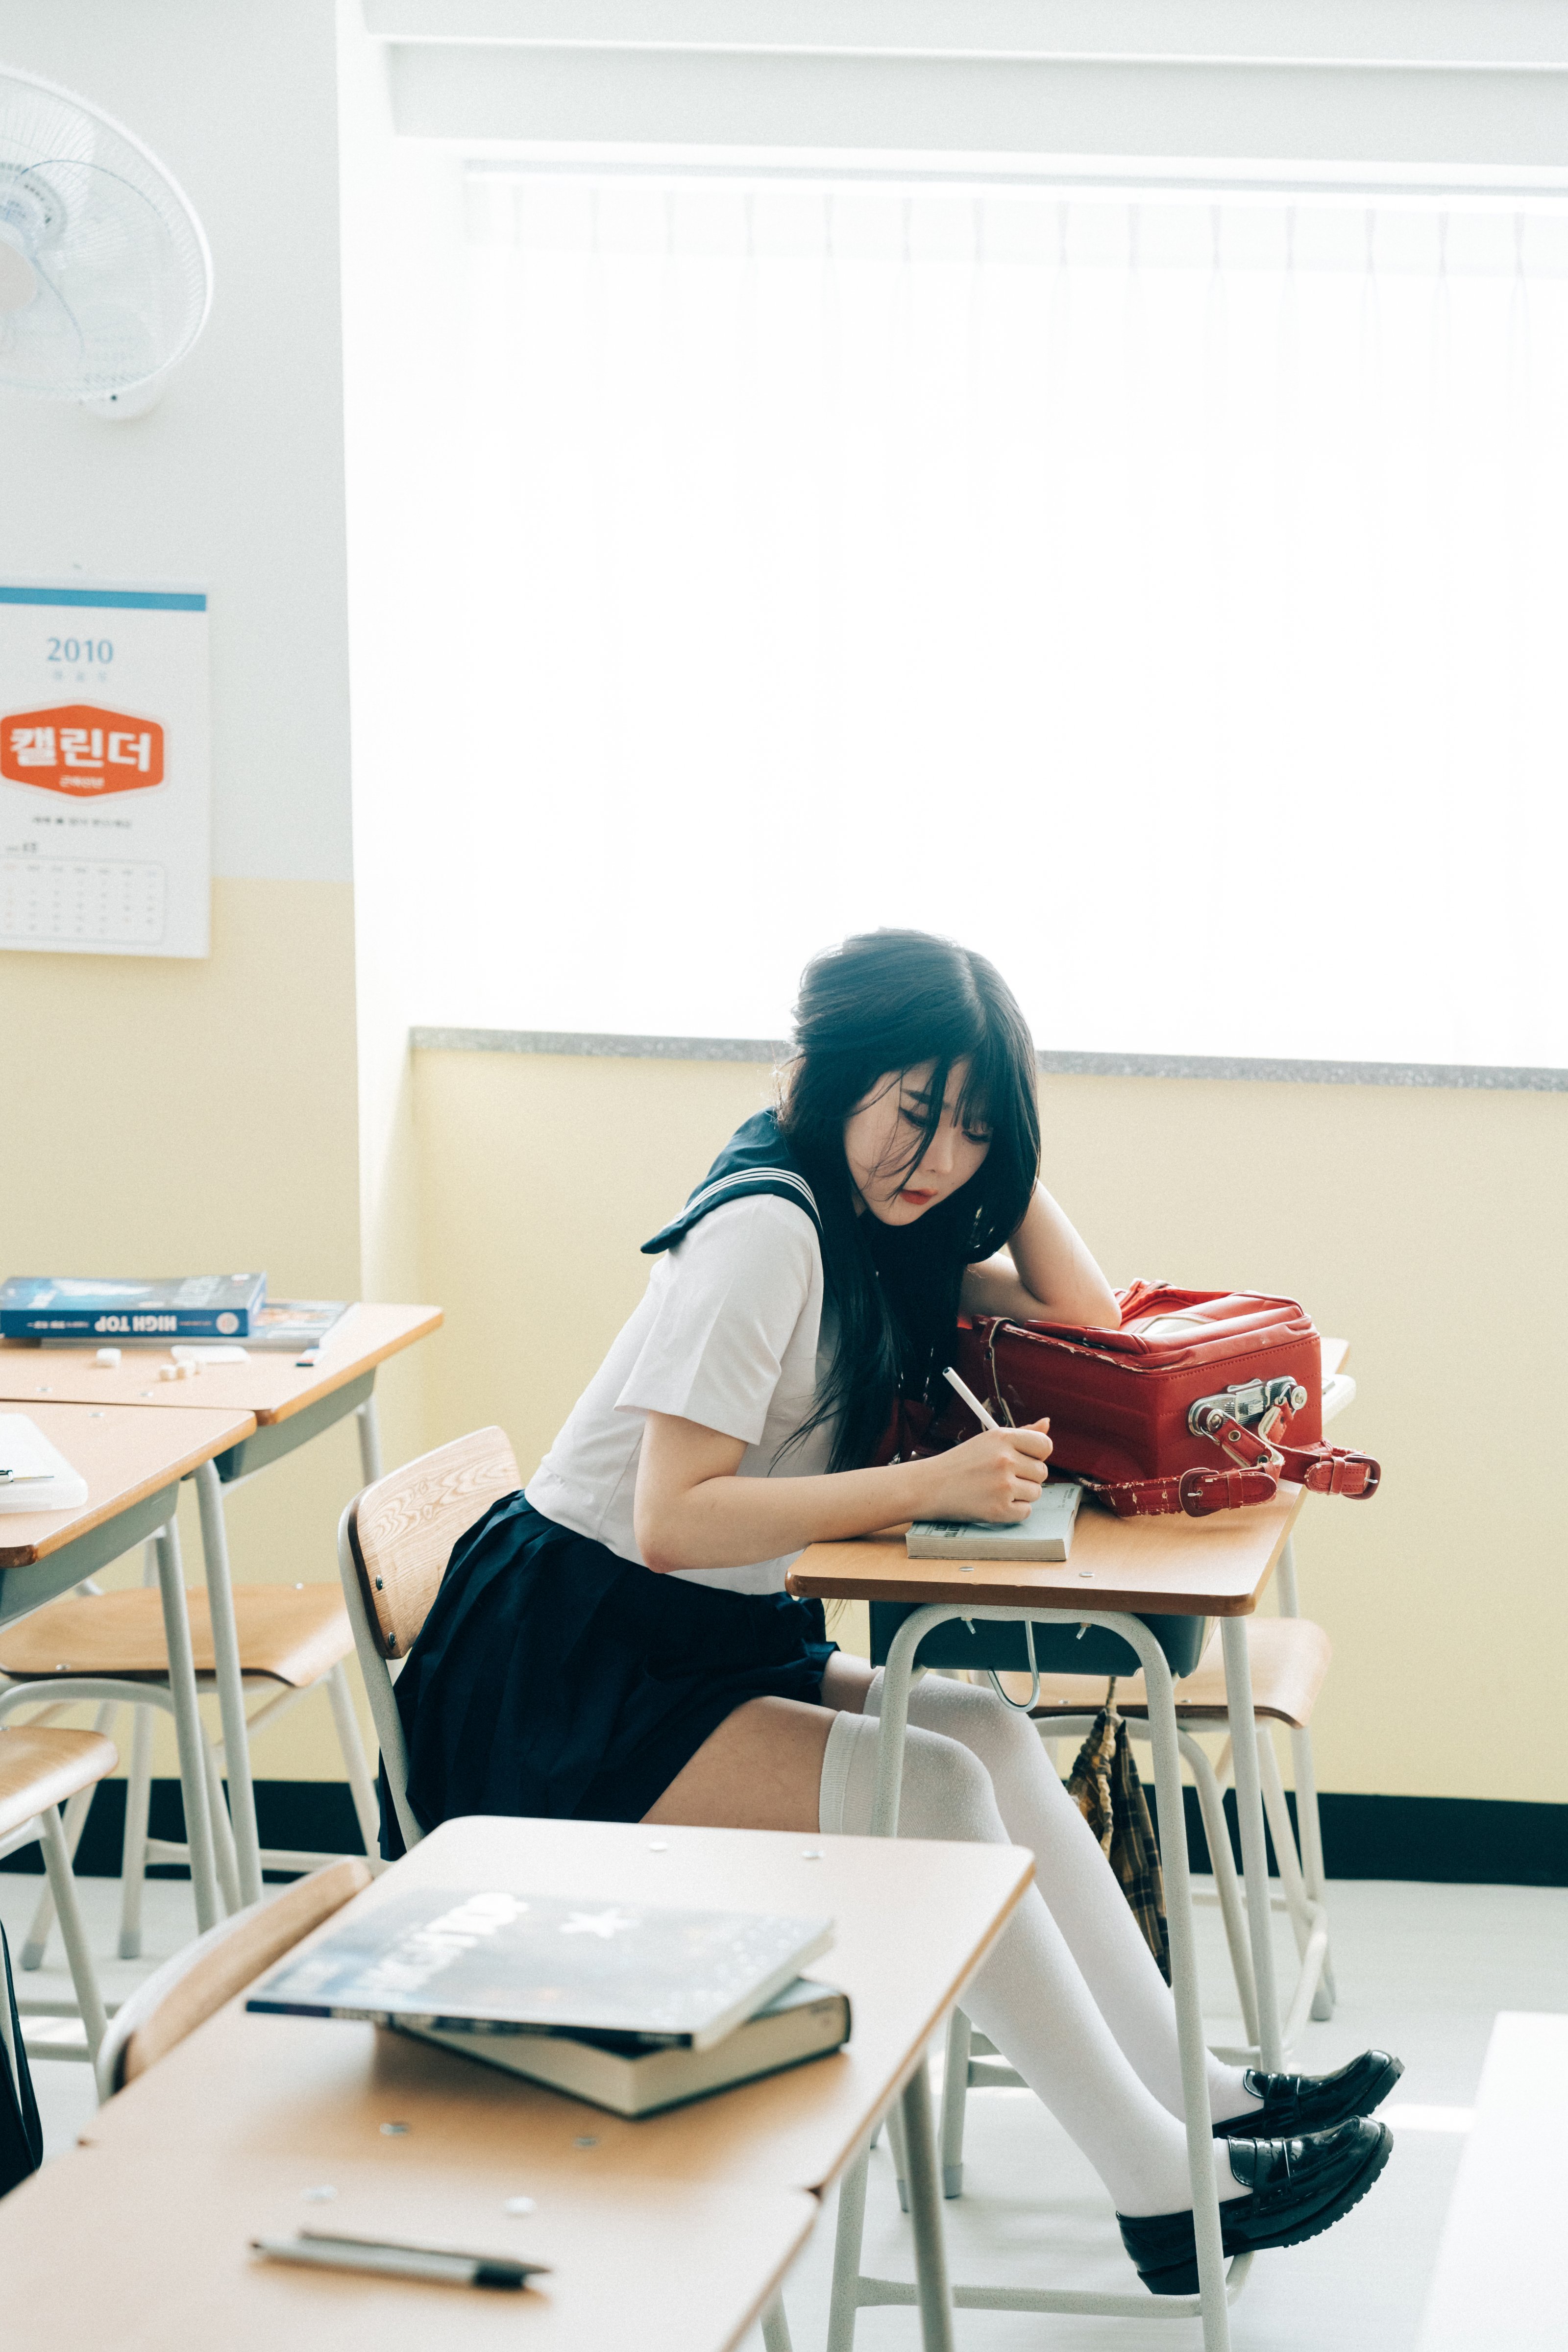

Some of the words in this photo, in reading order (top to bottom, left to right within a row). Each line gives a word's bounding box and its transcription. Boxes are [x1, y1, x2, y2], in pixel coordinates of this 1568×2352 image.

[48, 637, 114, 664] 2010
[10, 726, 151, 772] 캘린더
[94, 1315, 130, 1332] TOP
[132, 1315, 177, 1332] HIGH
